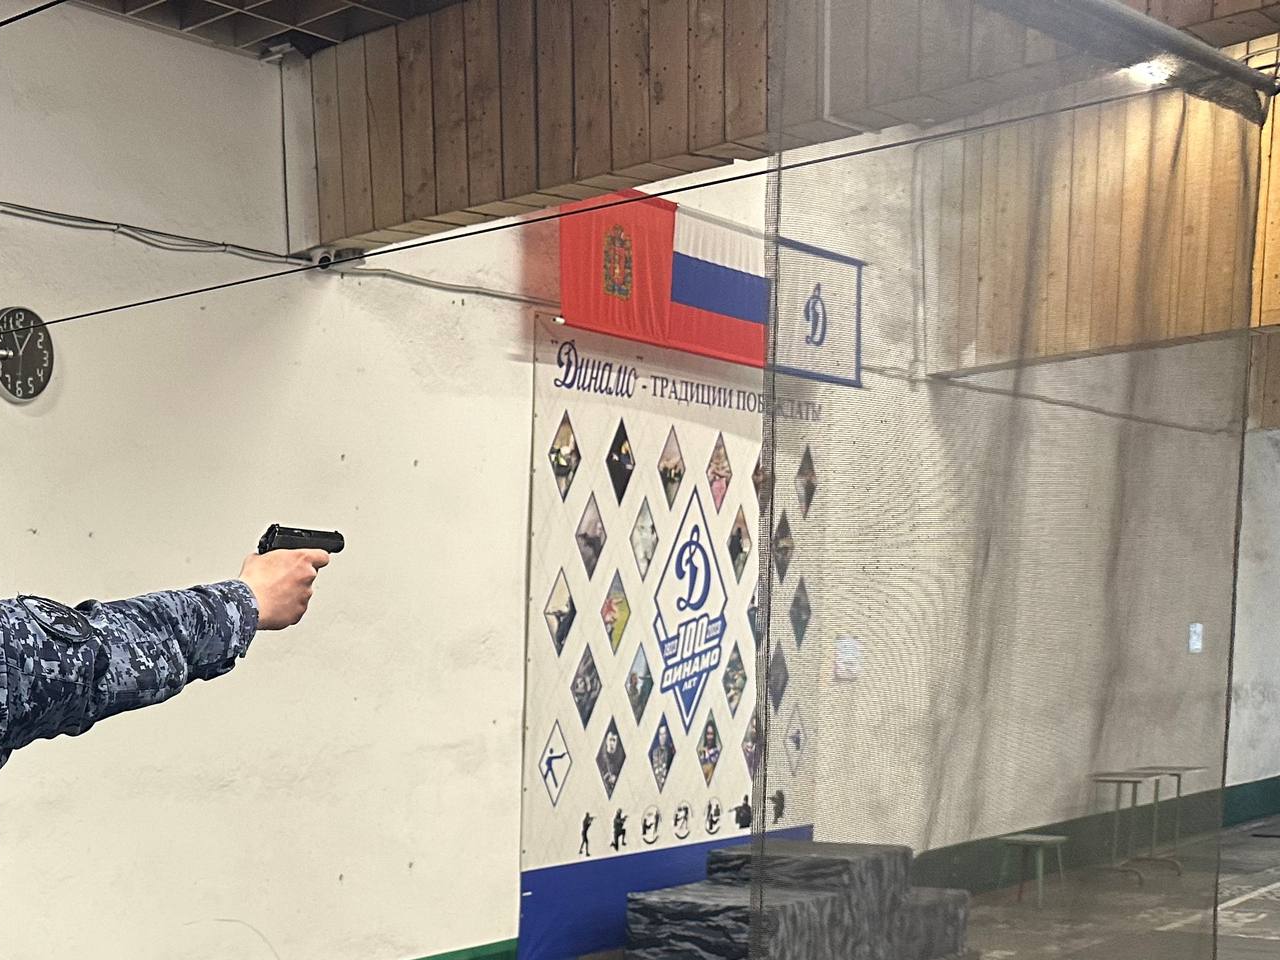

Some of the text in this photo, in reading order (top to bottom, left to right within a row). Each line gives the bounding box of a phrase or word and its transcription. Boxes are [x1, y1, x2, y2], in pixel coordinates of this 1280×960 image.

[37, 333, 44, 349] 2
[43, 351, 49, 367] 3
[5, 374, 12, 390] 7
[37, 368, 44, 382] 4
[16, 381, 23, 397] 6
[28, 377, 35, 394] 5
[650, 375, 733, 411] ТРАДИЦИИ
[668, 614, 718, 665] 100
[661, 647, 720, 689] ДИНАМО
